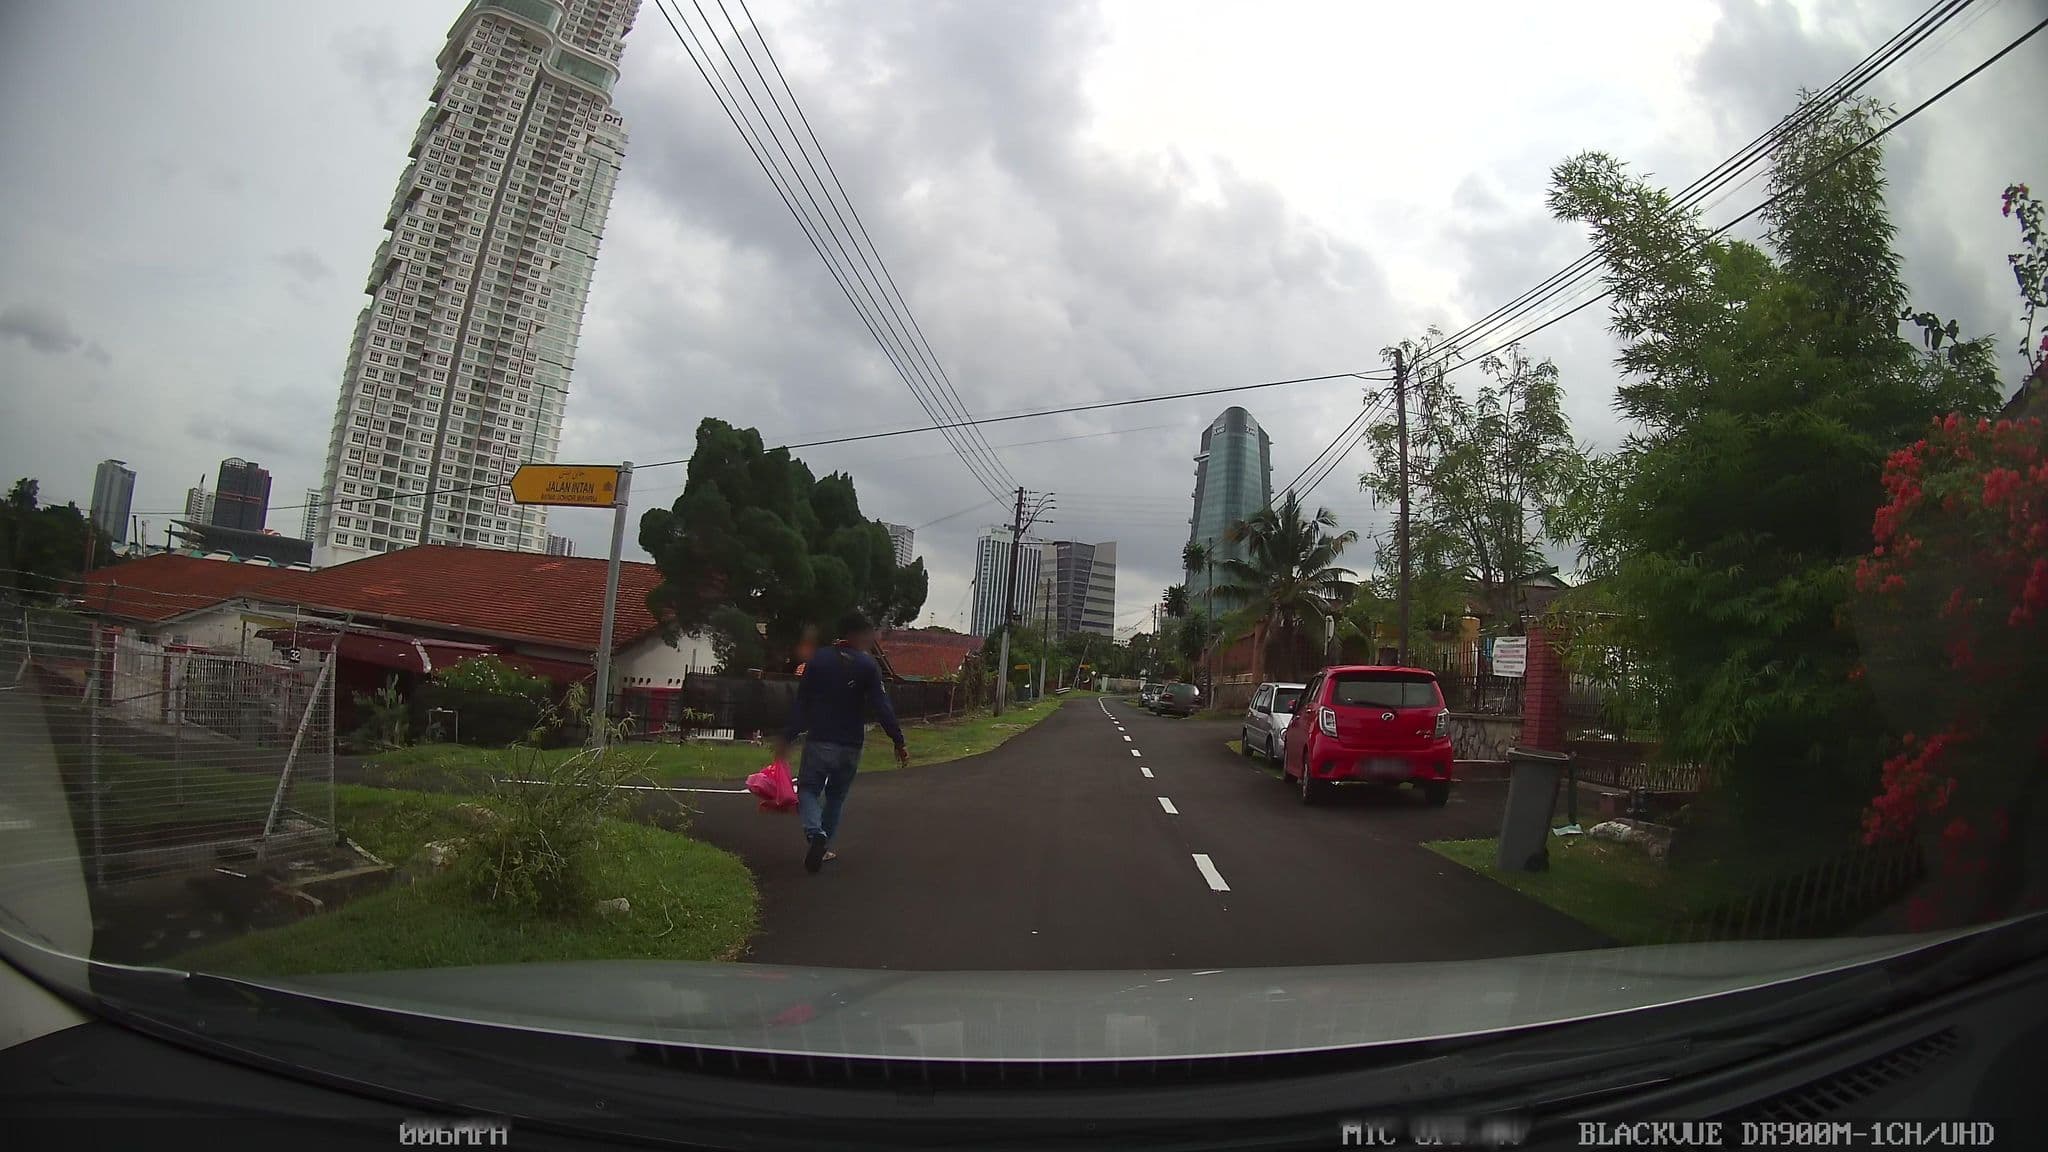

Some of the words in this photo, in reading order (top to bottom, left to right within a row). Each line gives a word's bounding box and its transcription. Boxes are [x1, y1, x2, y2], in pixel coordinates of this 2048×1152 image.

[546, 481, 571, 492] JALAN
[571, 482, 595, 494] INTAN
[290, 650, 300, 660] 32
